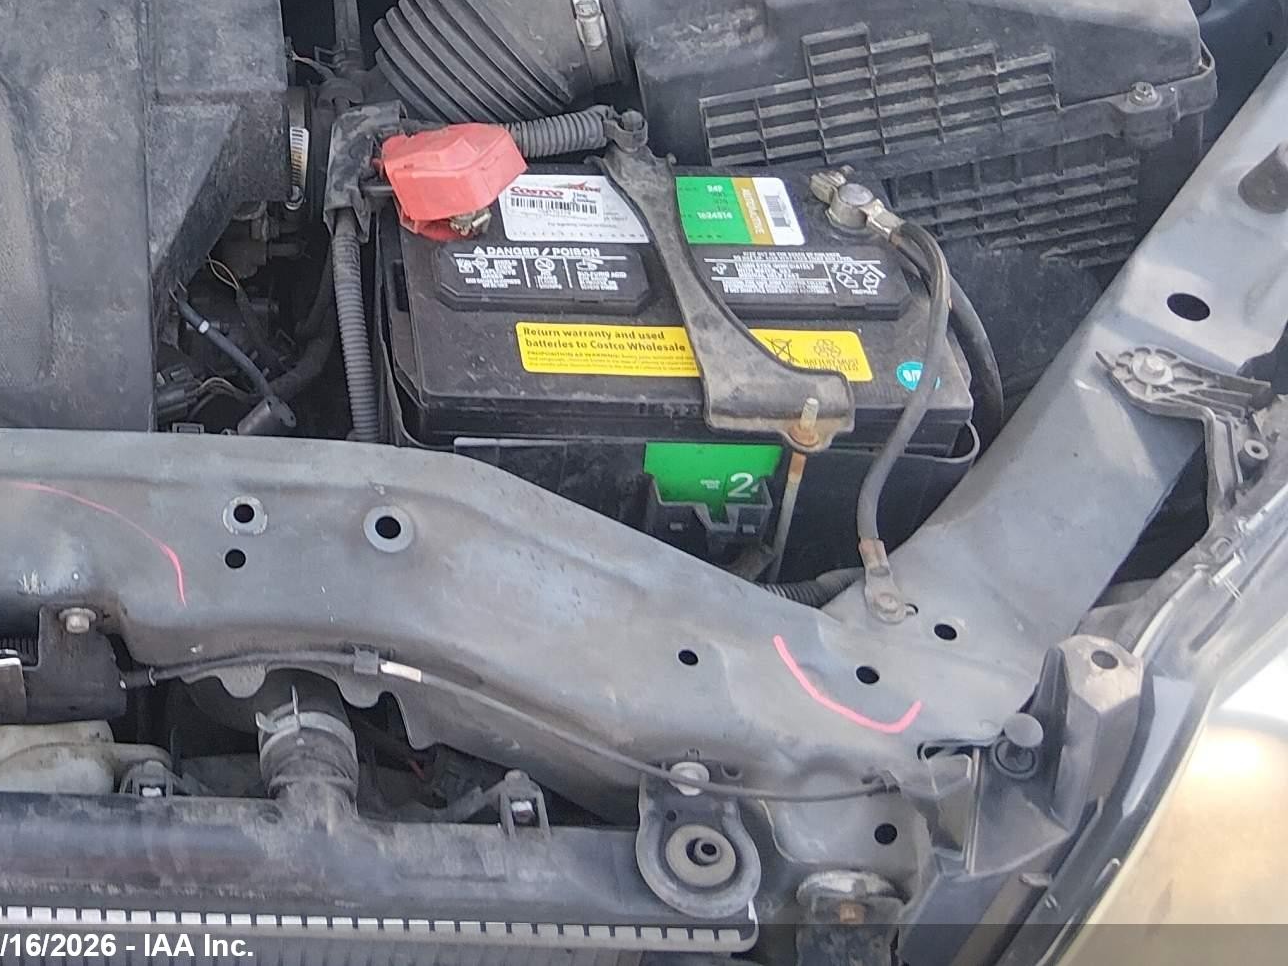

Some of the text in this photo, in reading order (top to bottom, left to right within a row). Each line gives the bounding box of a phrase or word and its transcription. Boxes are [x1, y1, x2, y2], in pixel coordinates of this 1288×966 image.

[510, 186, 564, 196] COSTCO
[486, 246, 539, 257] DANGER
[552, 247, 600, 258] POISON
[523, 327, 665, 340] Return warranty and used
[525, 338, 574, 348] batteries
[590, 340, 625, 350] Costco
[627, 342, 686, 352] Wholesale
